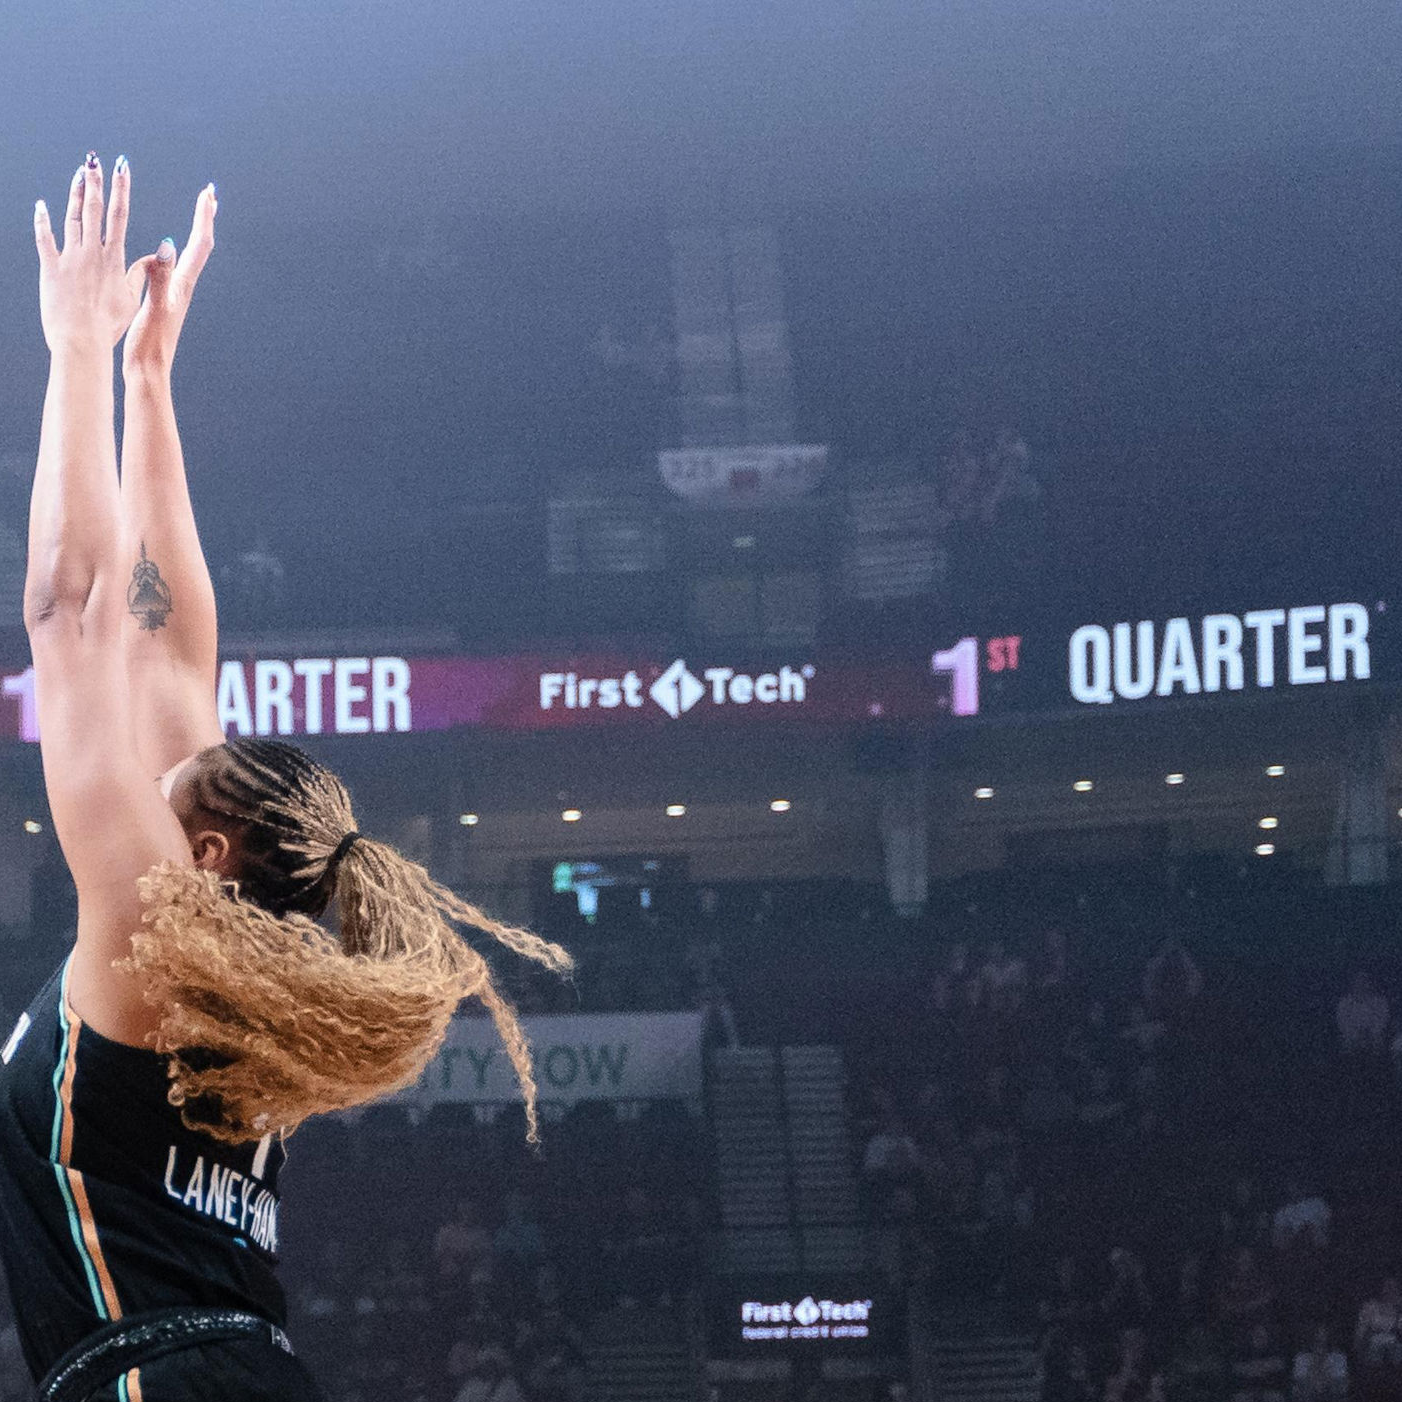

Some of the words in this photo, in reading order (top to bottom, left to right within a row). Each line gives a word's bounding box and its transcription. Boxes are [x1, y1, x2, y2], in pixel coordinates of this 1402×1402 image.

[539, 670, 644, 711] First
[1068, 602, 1371, 705] QUARTER
[217, 656, 412, 736] ARTER
